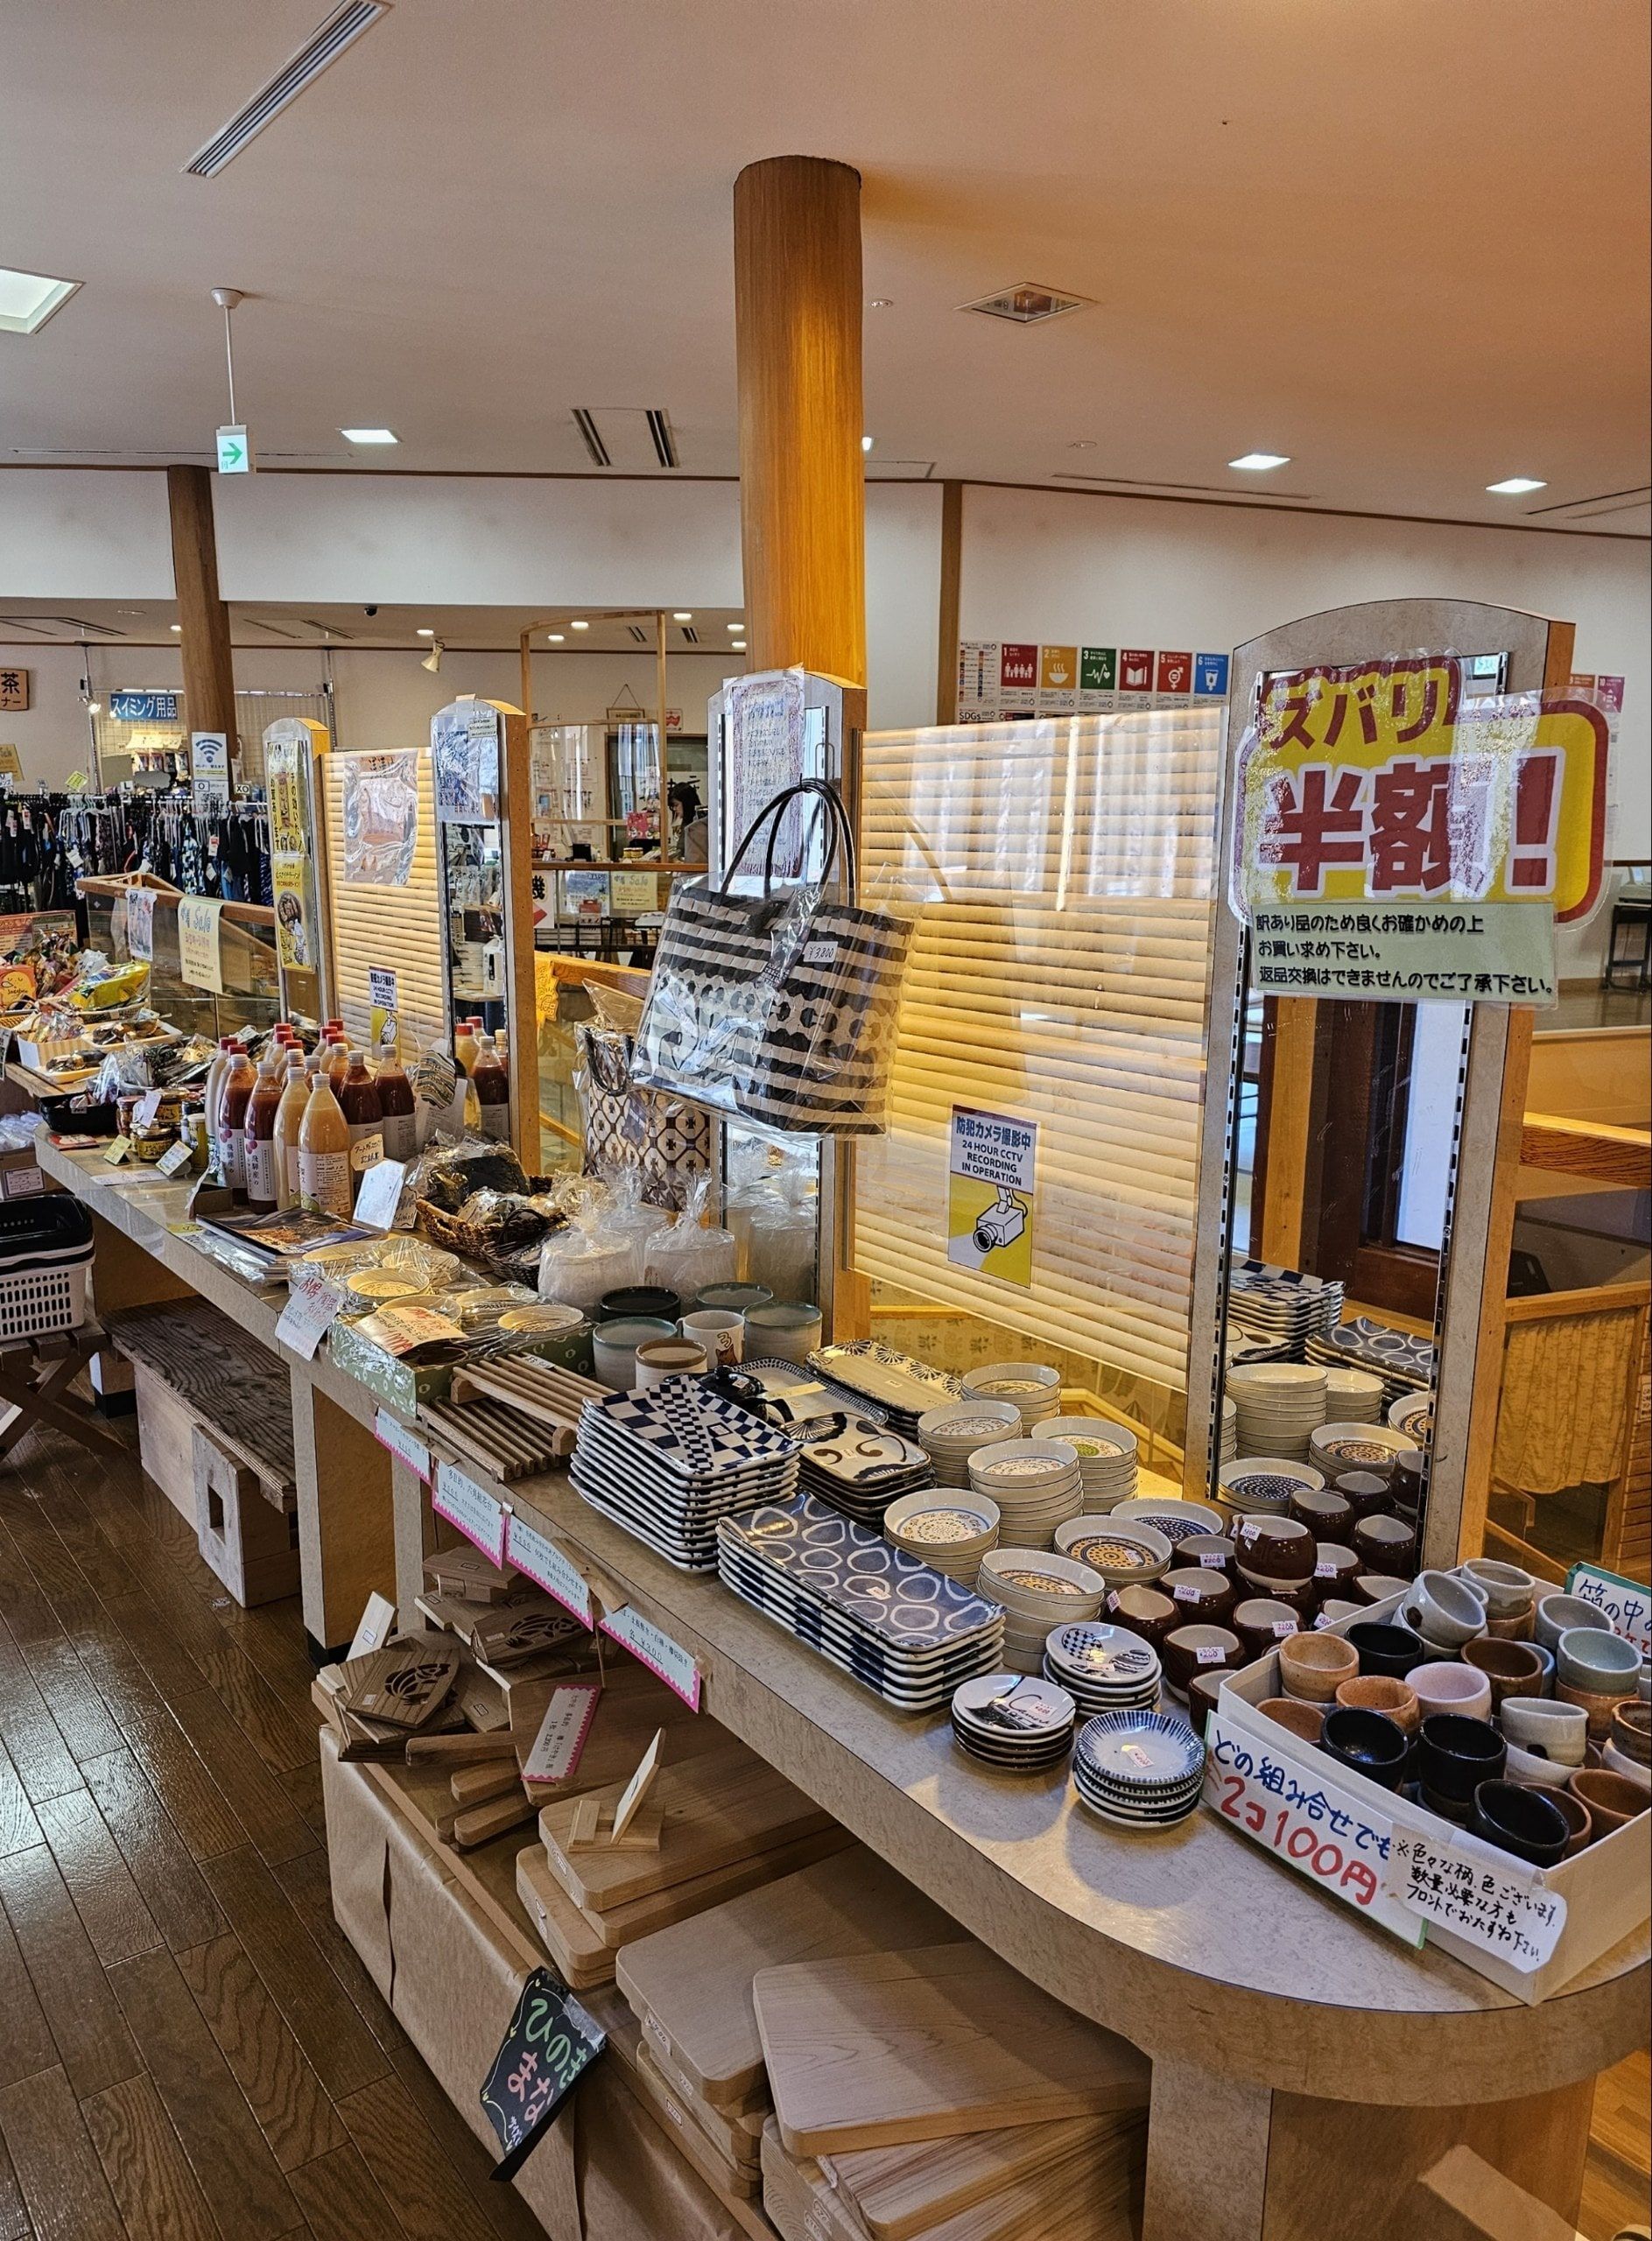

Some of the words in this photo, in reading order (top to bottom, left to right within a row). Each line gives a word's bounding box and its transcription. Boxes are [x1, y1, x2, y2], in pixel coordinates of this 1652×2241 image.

[1083, 650, 1089, 660] 3
[1122, 652, 1128, 662] 4
[1161, 654, 1166, 664] 5
[1198, 656, 1203, 665] 6
[1, 672, 20, 694] 茶
[112, 695, 177, 718] スイミング用品
[959, 712, 981, 720] SDGs
[1270, 675, 1439, 751] ズバリ
[1255, 913, 1485, 934] 訳あり品のため良くお確かめの上
[1258, 939, 1381, 959] お買い求め下さい。
[1259, 966, 1553, 996] 返品交換はできませんのでご了承下さい。
[956, 1116, 1031, 1151] 防犯カメラ撮影中
[962, 1139, 973, 1150] 24
[974, 1143, 998, 1156] HOUR
[1000, 1149, 1023, 1163] CCTV
[967, 1151, 1017, 1173] RECORDING
[961, 1163, 971, 1172] IN
[973, 1164, 1022, 1186] OPERATION
[1213, 1730, 1391, 1861] どの組み合せでも
[1220, 1775, 1378, 1906] 2コ100円
[1410, 1865, 1517, 1924] 数量必要な方も
[525, 1998, 587, 2090] ひのき
[508, 2052, 554, 2126] まな
